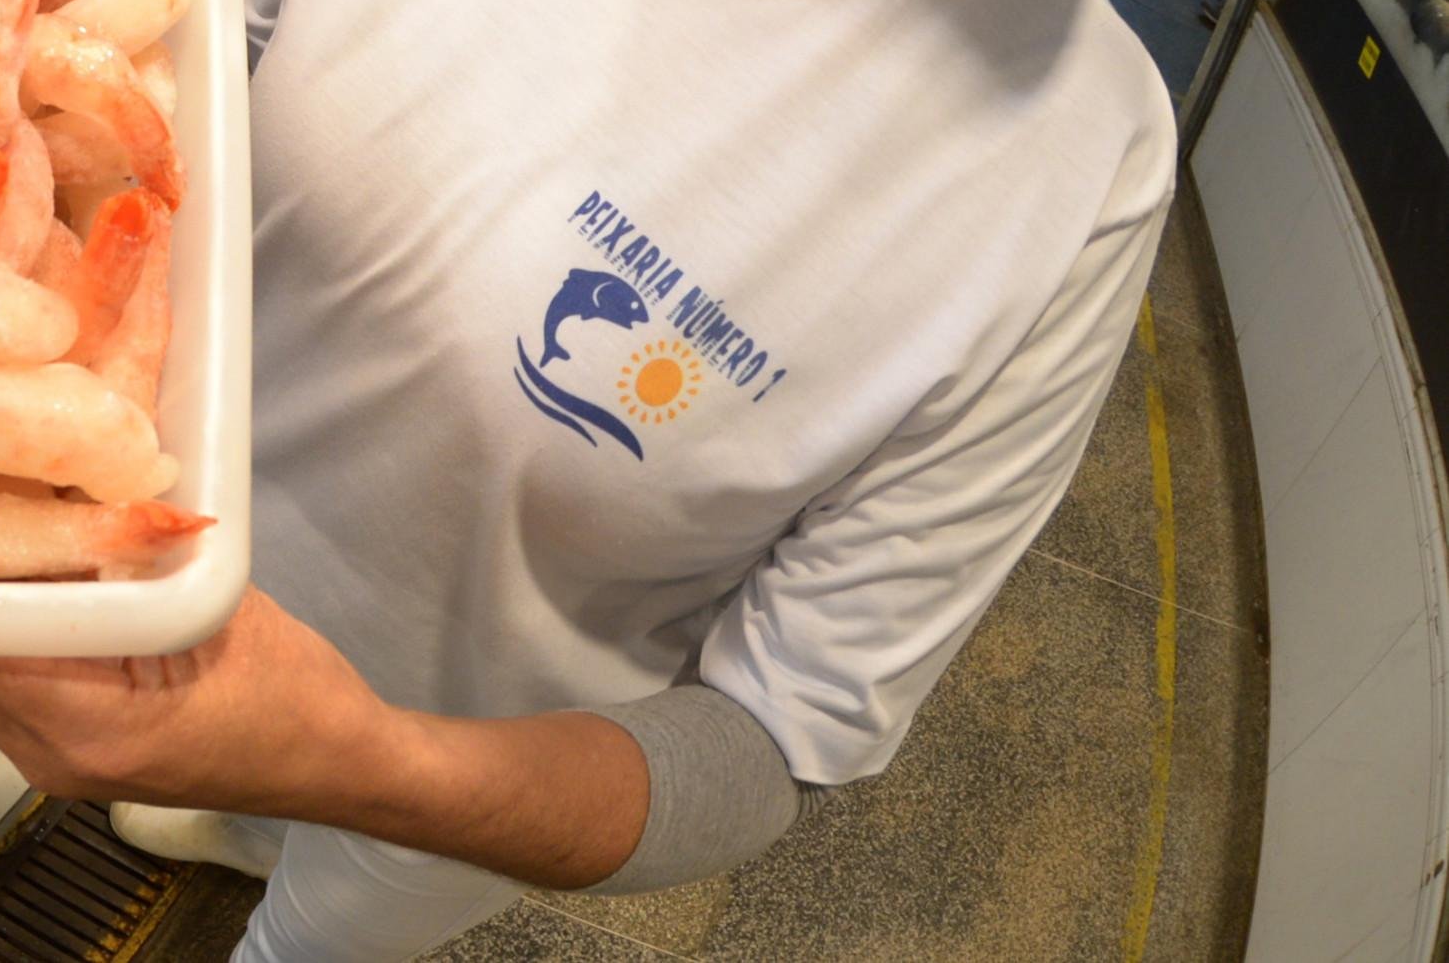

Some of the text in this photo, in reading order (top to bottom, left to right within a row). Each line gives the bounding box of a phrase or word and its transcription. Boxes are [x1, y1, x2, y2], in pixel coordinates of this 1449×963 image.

[570, 190, 787, 402] PEIXARIA NÚMERO 1
